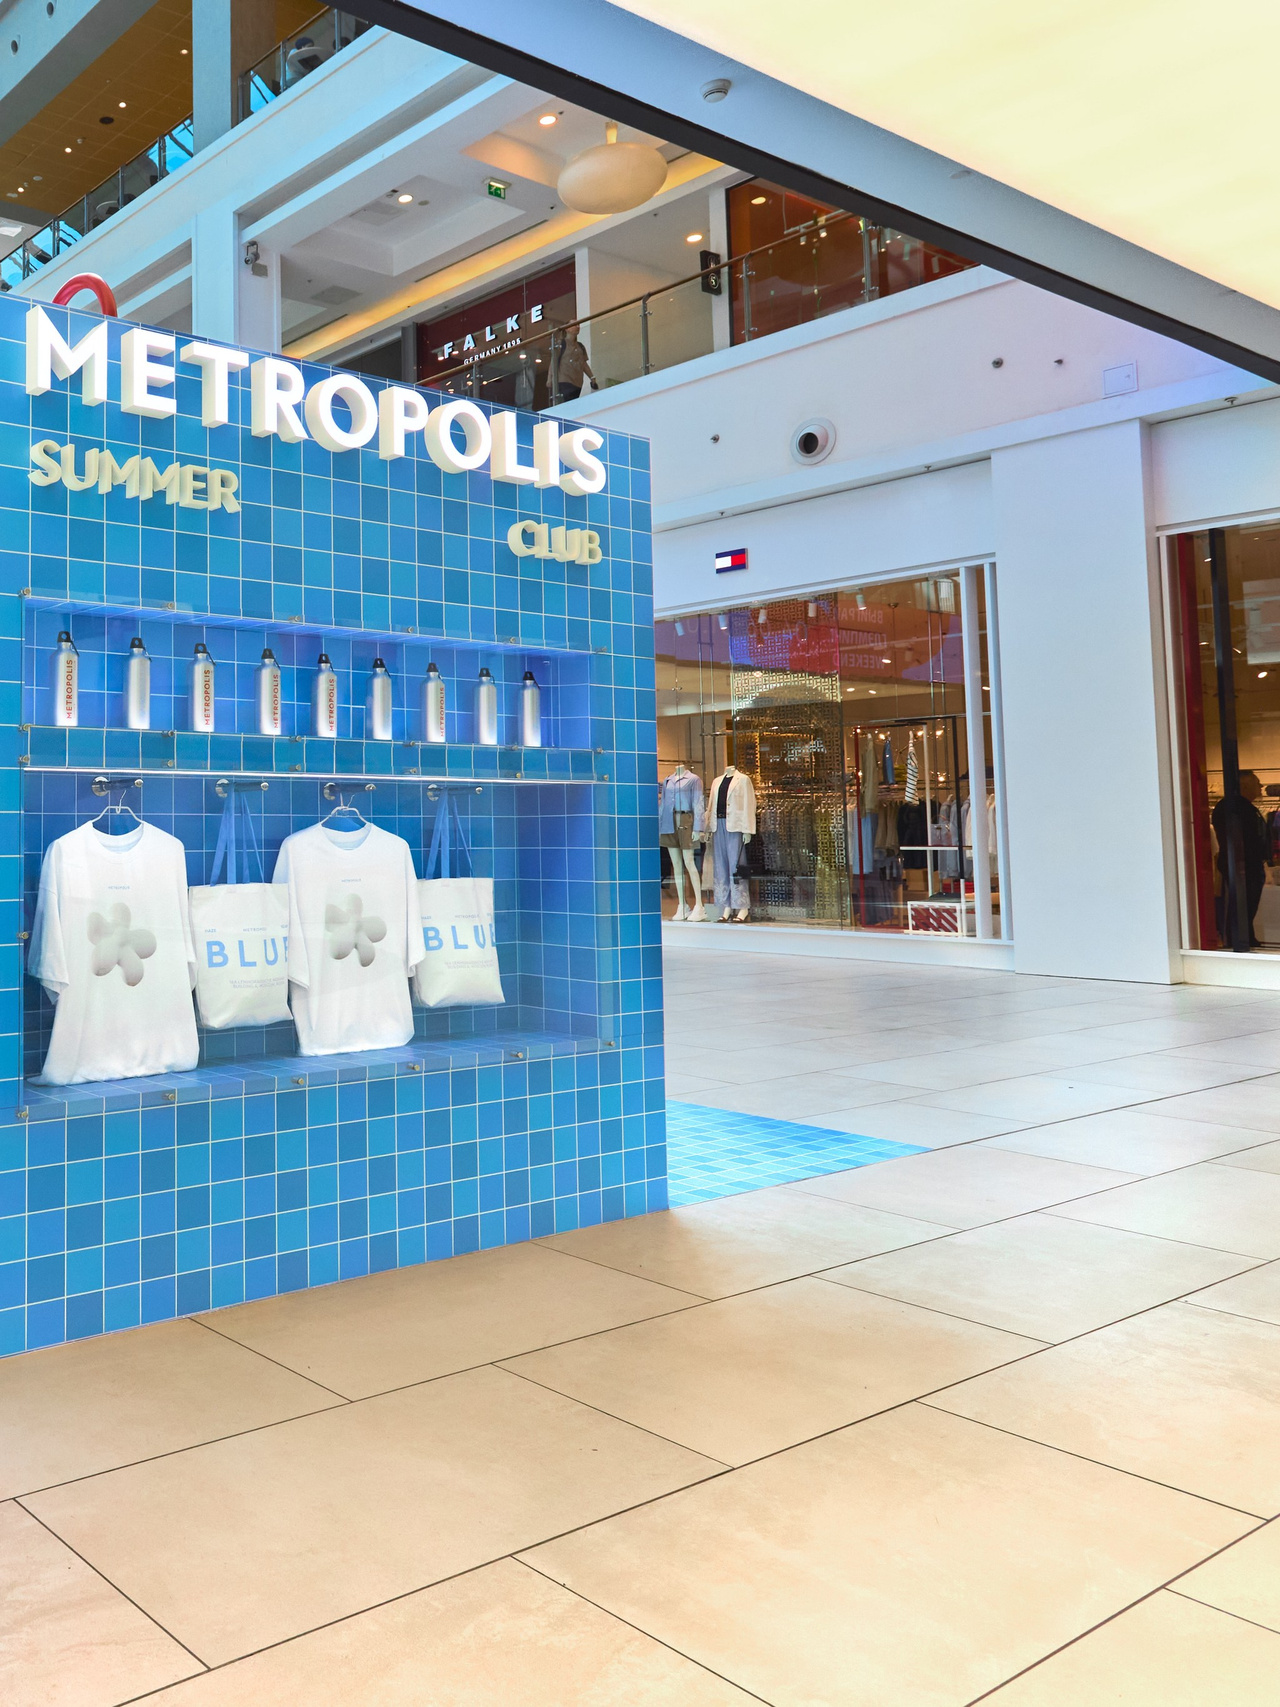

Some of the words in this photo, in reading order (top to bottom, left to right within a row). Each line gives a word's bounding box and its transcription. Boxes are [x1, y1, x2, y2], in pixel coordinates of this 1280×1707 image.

[443, 304, 543, 359] FALKE
[463, 345, 502, 365] GERMANY
[25, 304, 607, 496] METROPOLIS
[27, 439, 242, 513] SUMMER
[507, 520, 603, 565] CLUB
[203, 669, 211, 726] METROPOLIS
